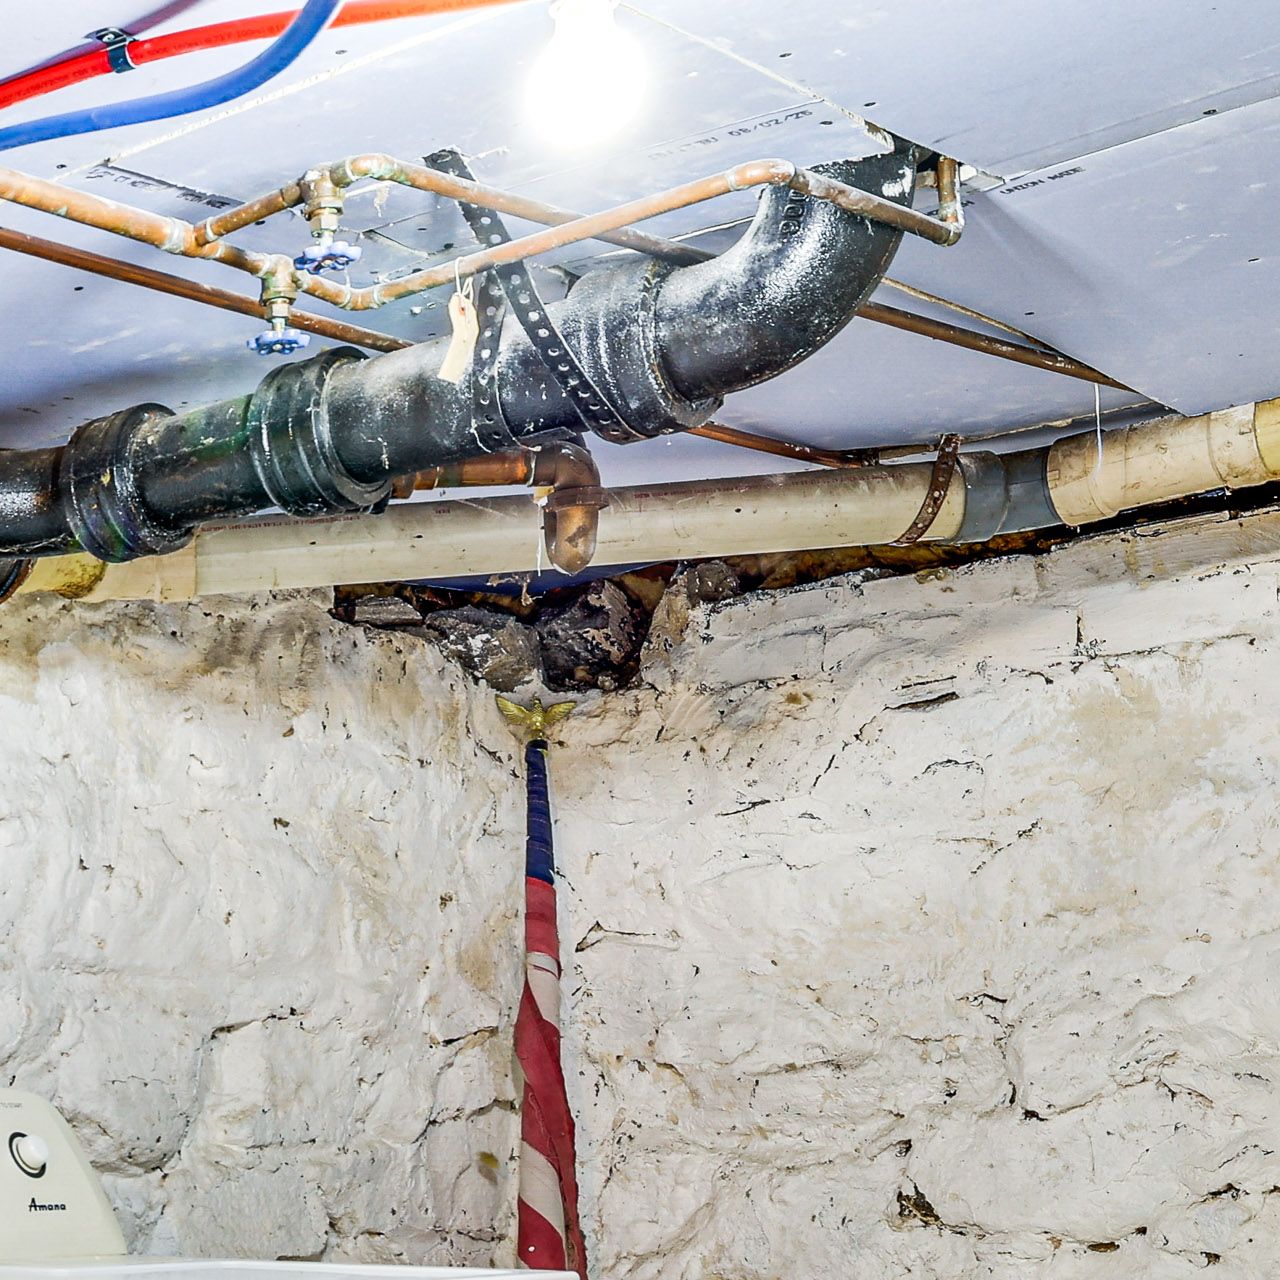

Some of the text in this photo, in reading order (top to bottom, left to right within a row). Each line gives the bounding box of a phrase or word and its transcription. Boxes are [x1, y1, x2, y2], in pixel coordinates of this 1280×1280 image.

[999, 166, 1086, 195] UNION MADE
[28, 1197, 67, 1212] Amana
